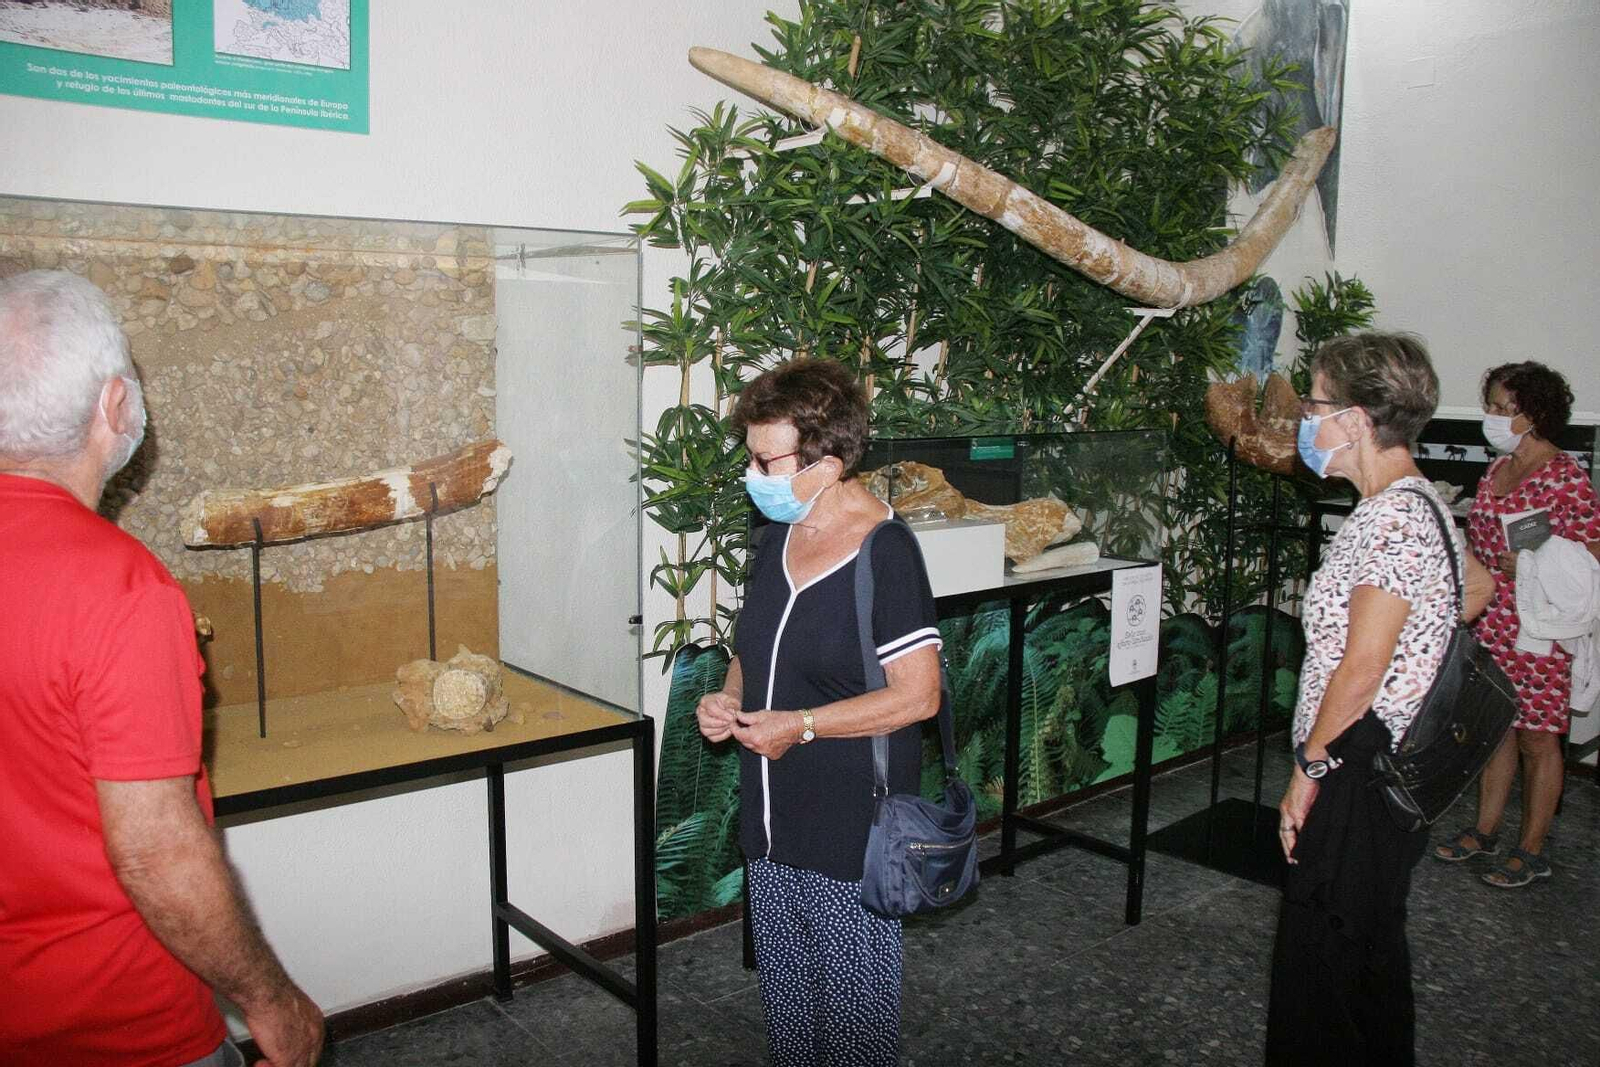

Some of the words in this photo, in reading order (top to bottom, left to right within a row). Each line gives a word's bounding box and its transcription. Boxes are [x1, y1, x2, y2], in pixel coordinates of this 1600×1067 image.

[27, 63, 46, 73] Son
[49, 66, 68, 77] dos
[69, 69, 84, 79] de
[85, 70, 100, 81] los
[101, 74, 159, 88] yacimientos
[160, 82, 232, 97] paleontológicos
[234, 89, 252, 99] más
[254, 93, 306, 105] meridionales
[307, 98, 320, 107] de
[321, 100, 349, 110] Europa
[65, 81, 100, 93] refugio
[101, 85, 116, 94] de
[117, 86, 132, 96] los
[133, 87, 166, 100] últimos
[169, 93, 227, 107] mastodontes
[227, 99, 243, 109] del
[244, 102, 256, 110] sur
[257, 102, 270, 112] de
[271, 104, 280, 113] la
